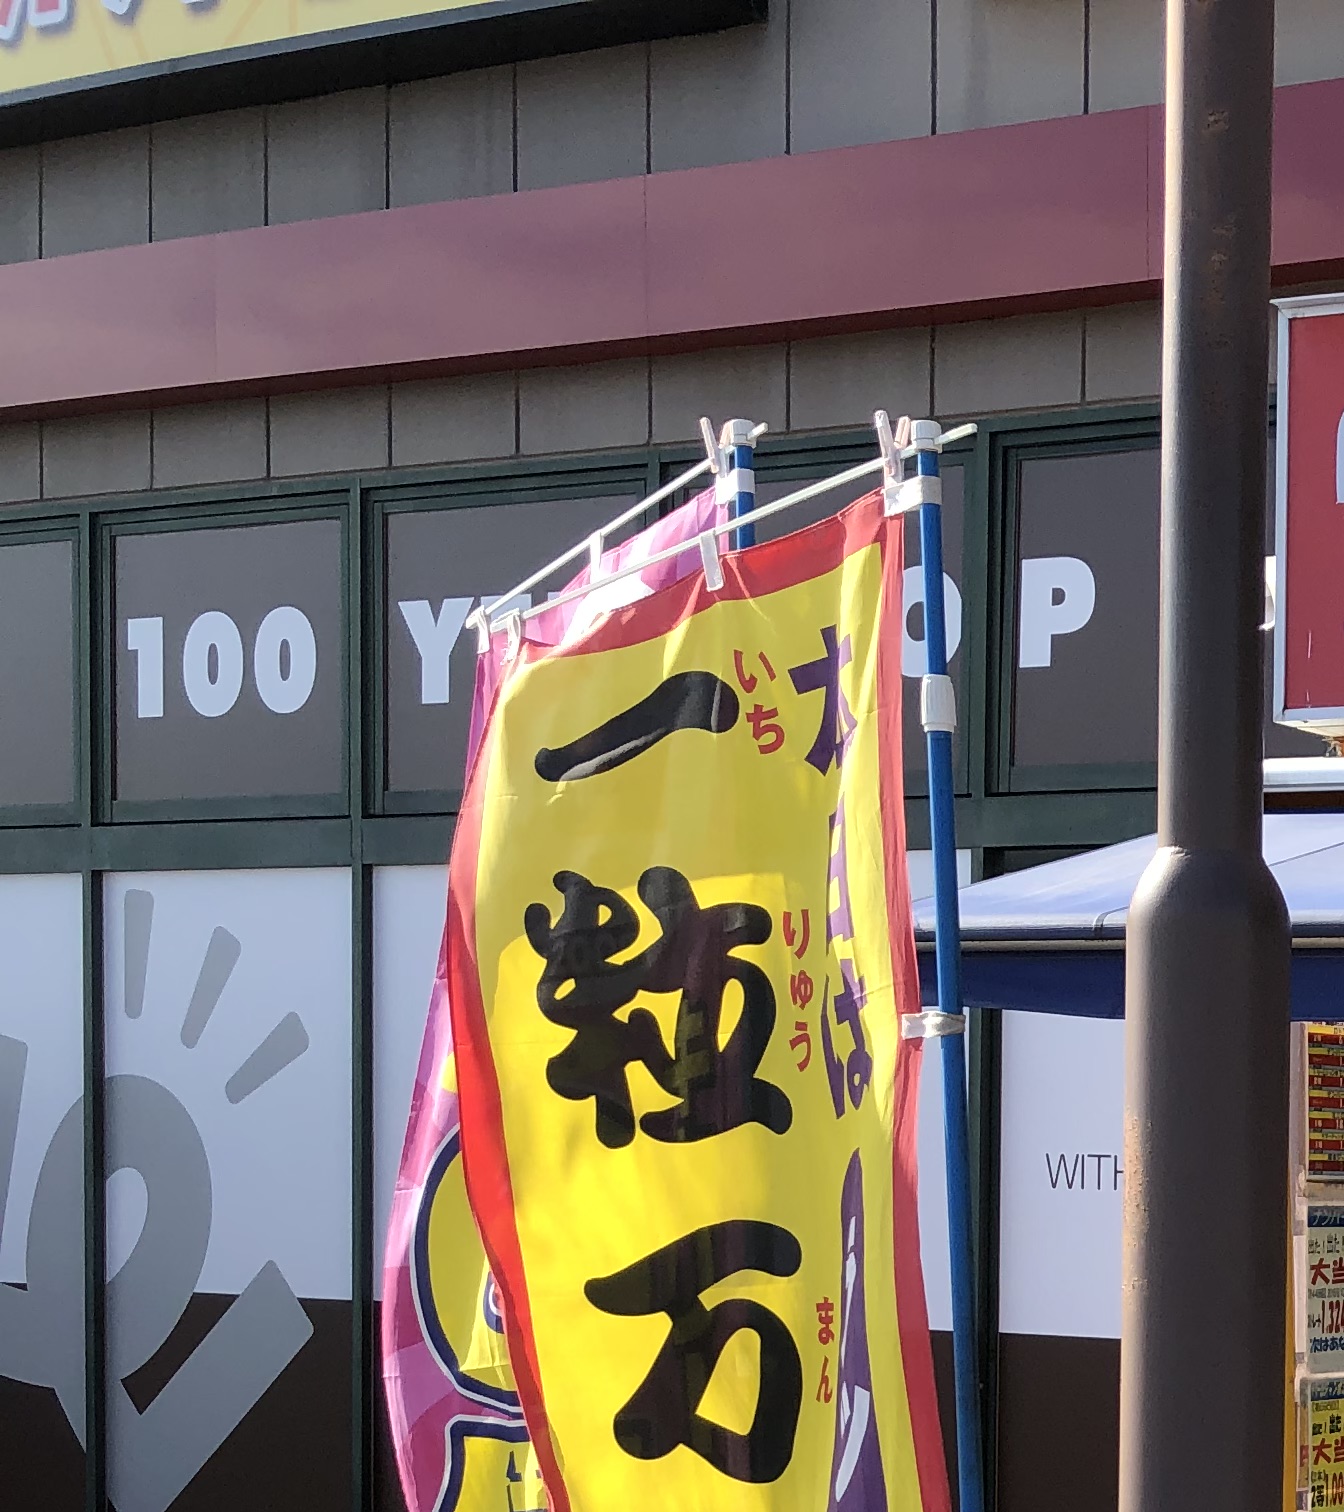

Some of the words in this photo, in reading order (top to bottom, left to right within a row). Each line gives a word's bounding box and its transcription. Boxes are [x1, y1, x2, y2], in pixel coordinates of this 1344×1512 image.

[127, 606, 317, 718] 100
[733, 648, 786, 755] いち
[1046, 1152, 1123, 1190] WITH
